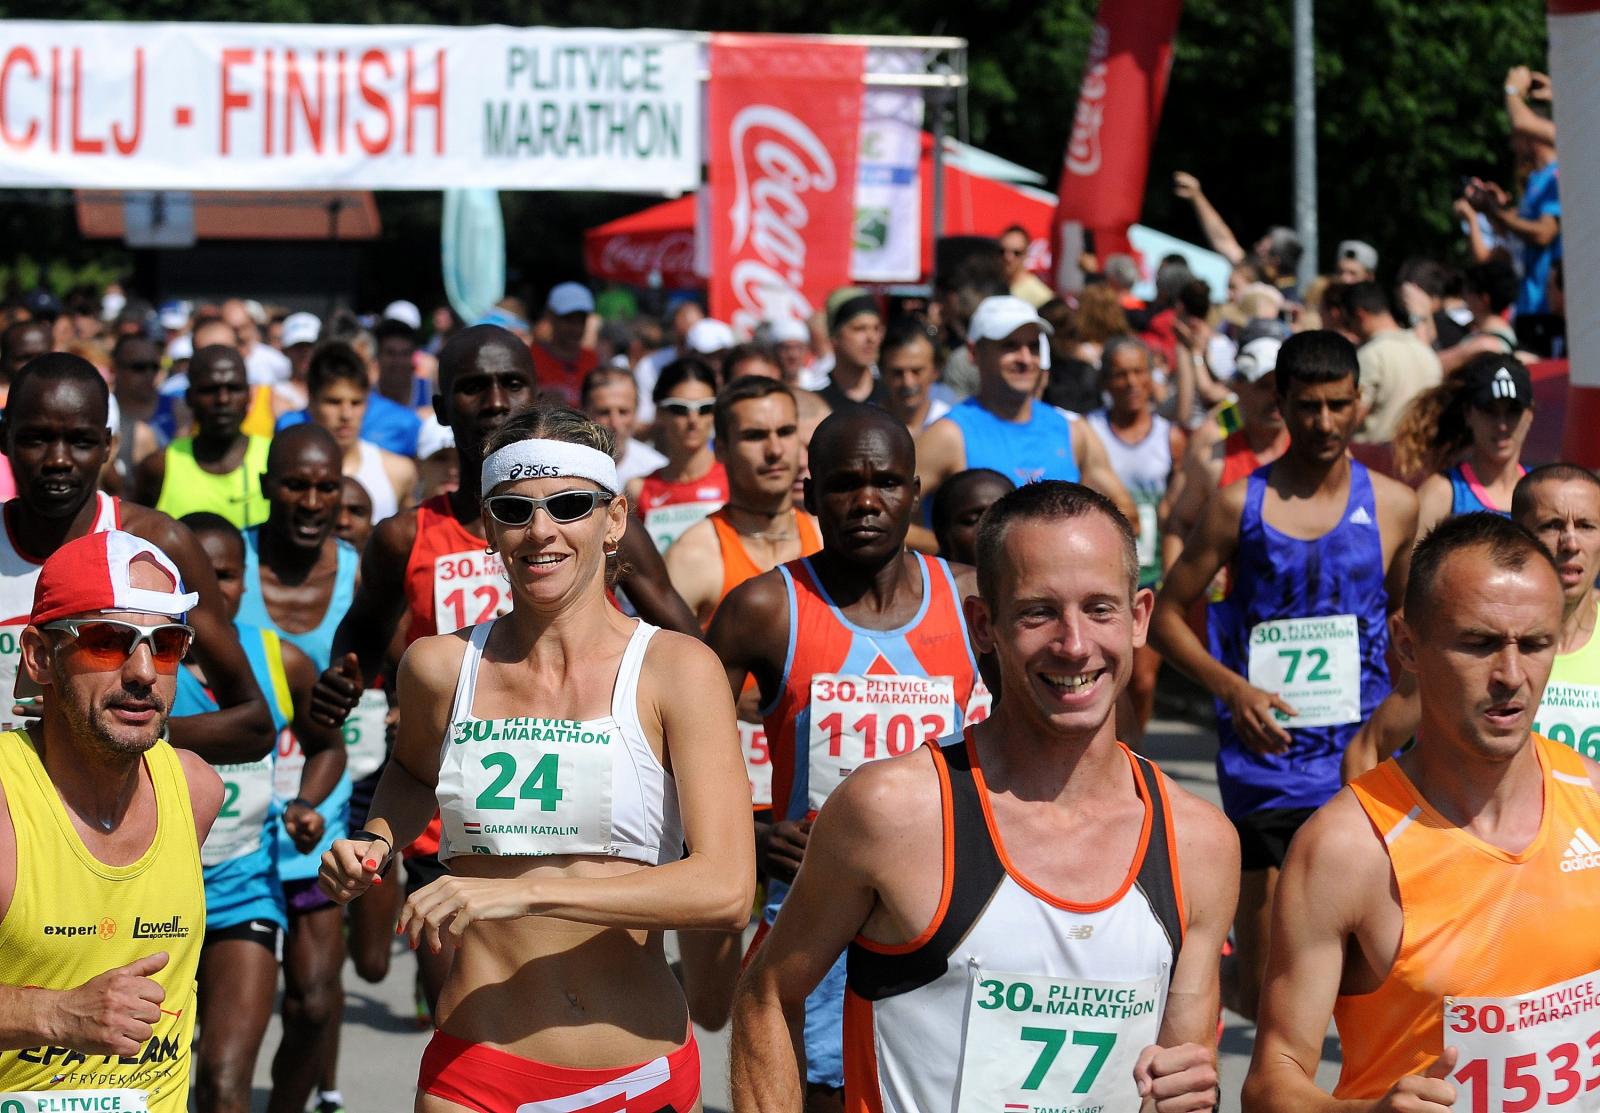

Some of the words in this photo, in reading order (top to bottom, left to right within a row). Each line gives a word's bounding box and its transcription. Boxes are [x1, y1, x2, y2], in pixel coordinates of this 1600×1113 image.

[507, 47, 662, 91] PLITVICE
[0, 45, 143, 155] CILJ
[219, 49, 446, 156] FINISH
[483, 102, 683, 158] MARATHON
[524, 465, 560, 477] asics
[440, 559, 481, 580] 30.
[443, 586, 513, 629] 12
[1255, 627, 1287, 644] 30.
[1278, 648, 1331, 684] 72
[816, 680, 864, 702] 30.
[866, 682, 928, 693] PLITVICE
[866, 693, 949, 704] MARATHON
[454, 719, 500, 744] 30.
[502, 727, 611, 744] MARATHON
[475, 752, 563, 812] 24
[484, 824, 527, 834] GARAMI
[531, 825, 578, 835] KATALIN
[44, 925, 97, 937] expert
[133, 916, 179, 938] Lowell
[977, 980, 1042, 1012] 30.
[1049, 985, 1136, 1003] PLITVICE
[1046, 999, 1155, 1019] MARATHON
[1450, 1005, 1515, 1034] 30.
[1519, 981, 1594, 1015] PLITVICE
[1020, 1026, 1118, 1094] 77
[37, 1096, 121, 1112] PLITVICE
